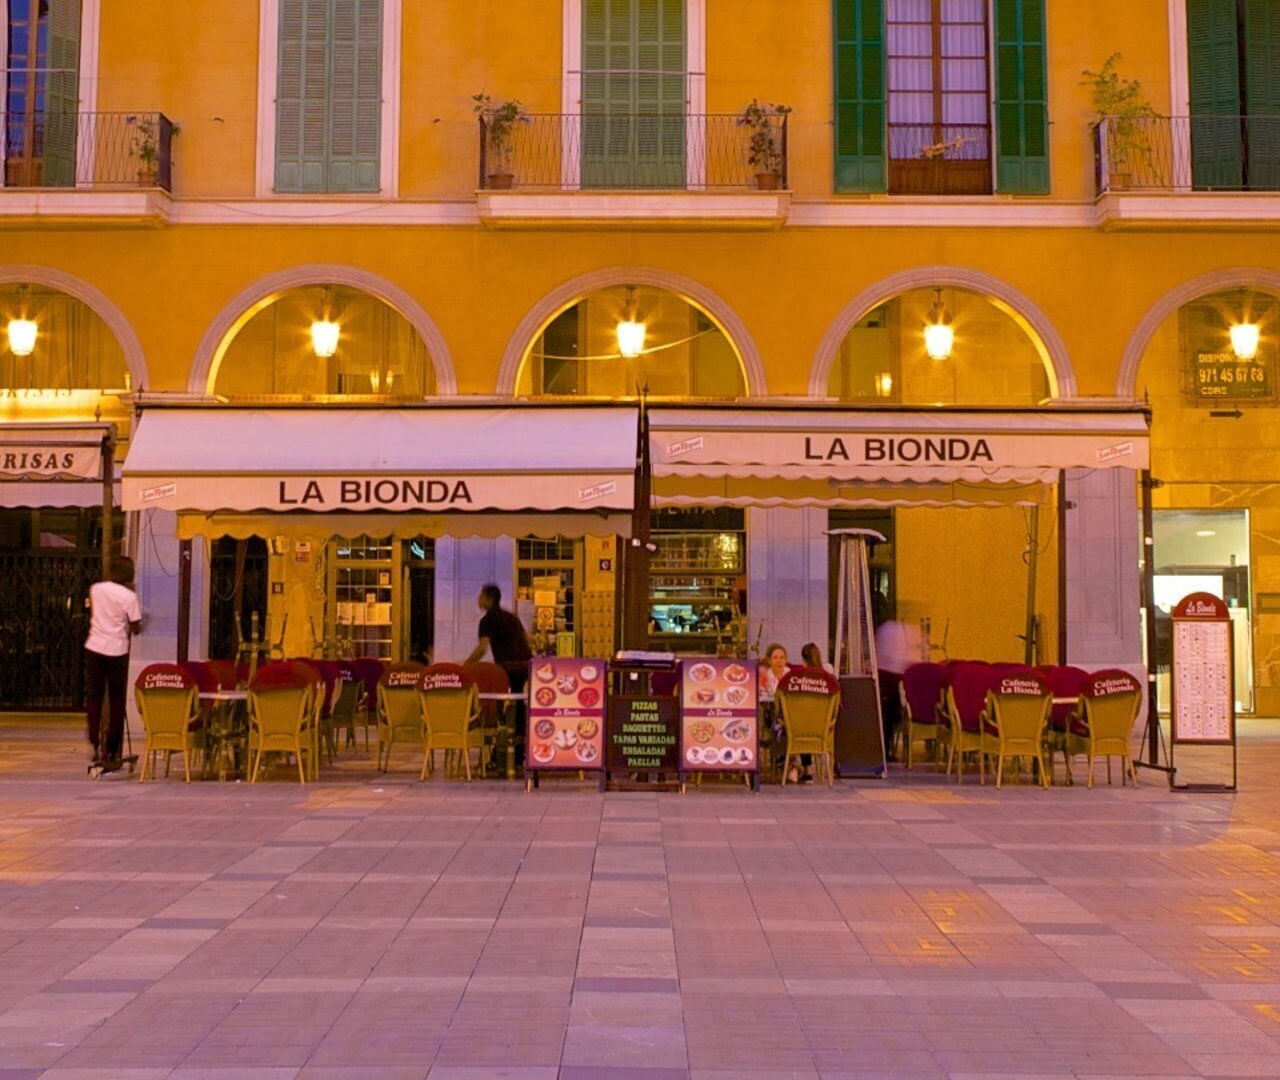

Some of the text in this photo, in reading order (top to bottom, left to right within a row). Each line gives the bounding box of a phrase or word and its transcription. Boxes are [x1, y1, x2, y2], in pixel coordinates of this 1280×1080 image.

[1200, 368, 1218, 382] 971
[1221, 368, 1234, 382] 45
[804, 437, 994, 461] LA BIONDA
[279, 480, 473, 504] LA BIONDA
[424, 682, 433, 690] La
[1094, 688, 1104, 696] La
[632, 702, 658, 710] PIZZAS
[631, 713, 659, 721] PASTAS
[622, 724, 666, 733] BAGUETTES
[613, 735, 676, 744] TAPAS VARIADAS
[622, 746, 666, 755] ENSALADAS
[628, 758, 661, 766] PAELLAS
